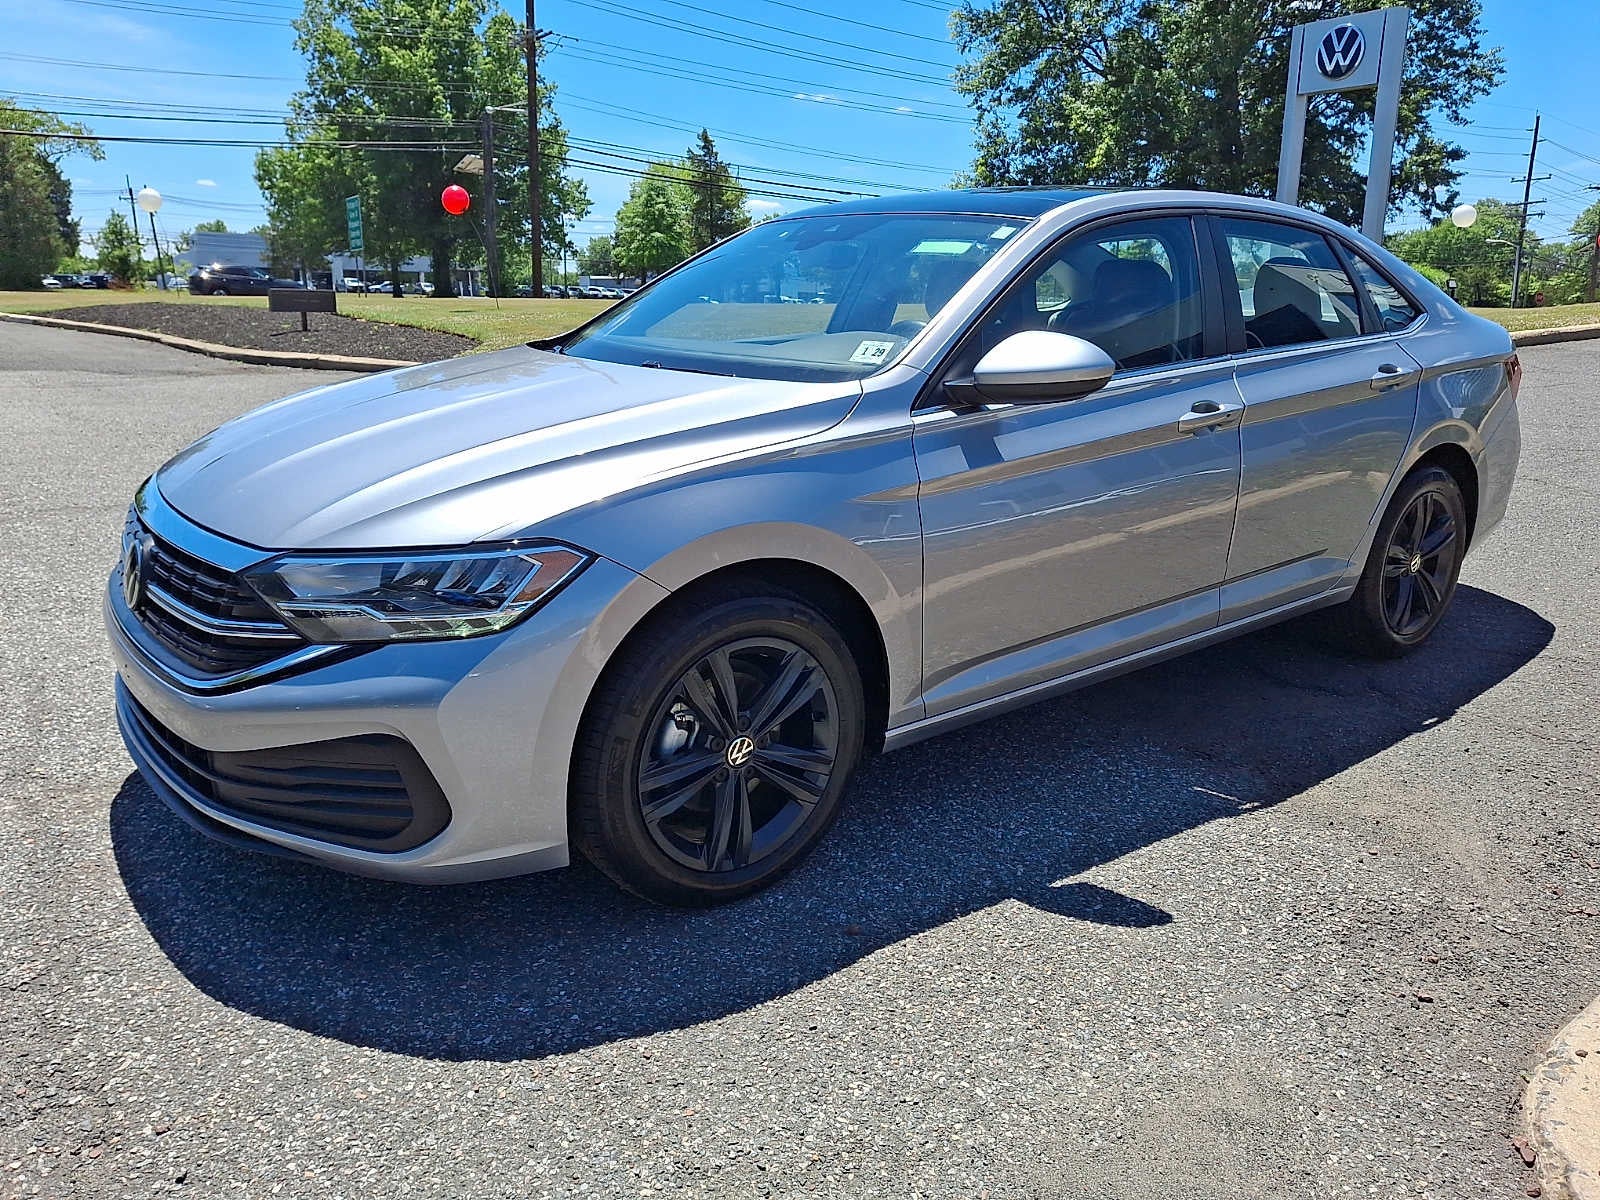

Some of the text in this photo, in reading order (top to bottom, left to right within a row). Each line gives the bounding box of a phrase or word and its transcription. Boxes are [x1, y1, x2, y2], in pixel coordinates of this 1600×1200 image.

[1317, 25, 1365, 77] VW
[861, 346, 886, 357] 1 29
[728, 737, 754, 767] VW
